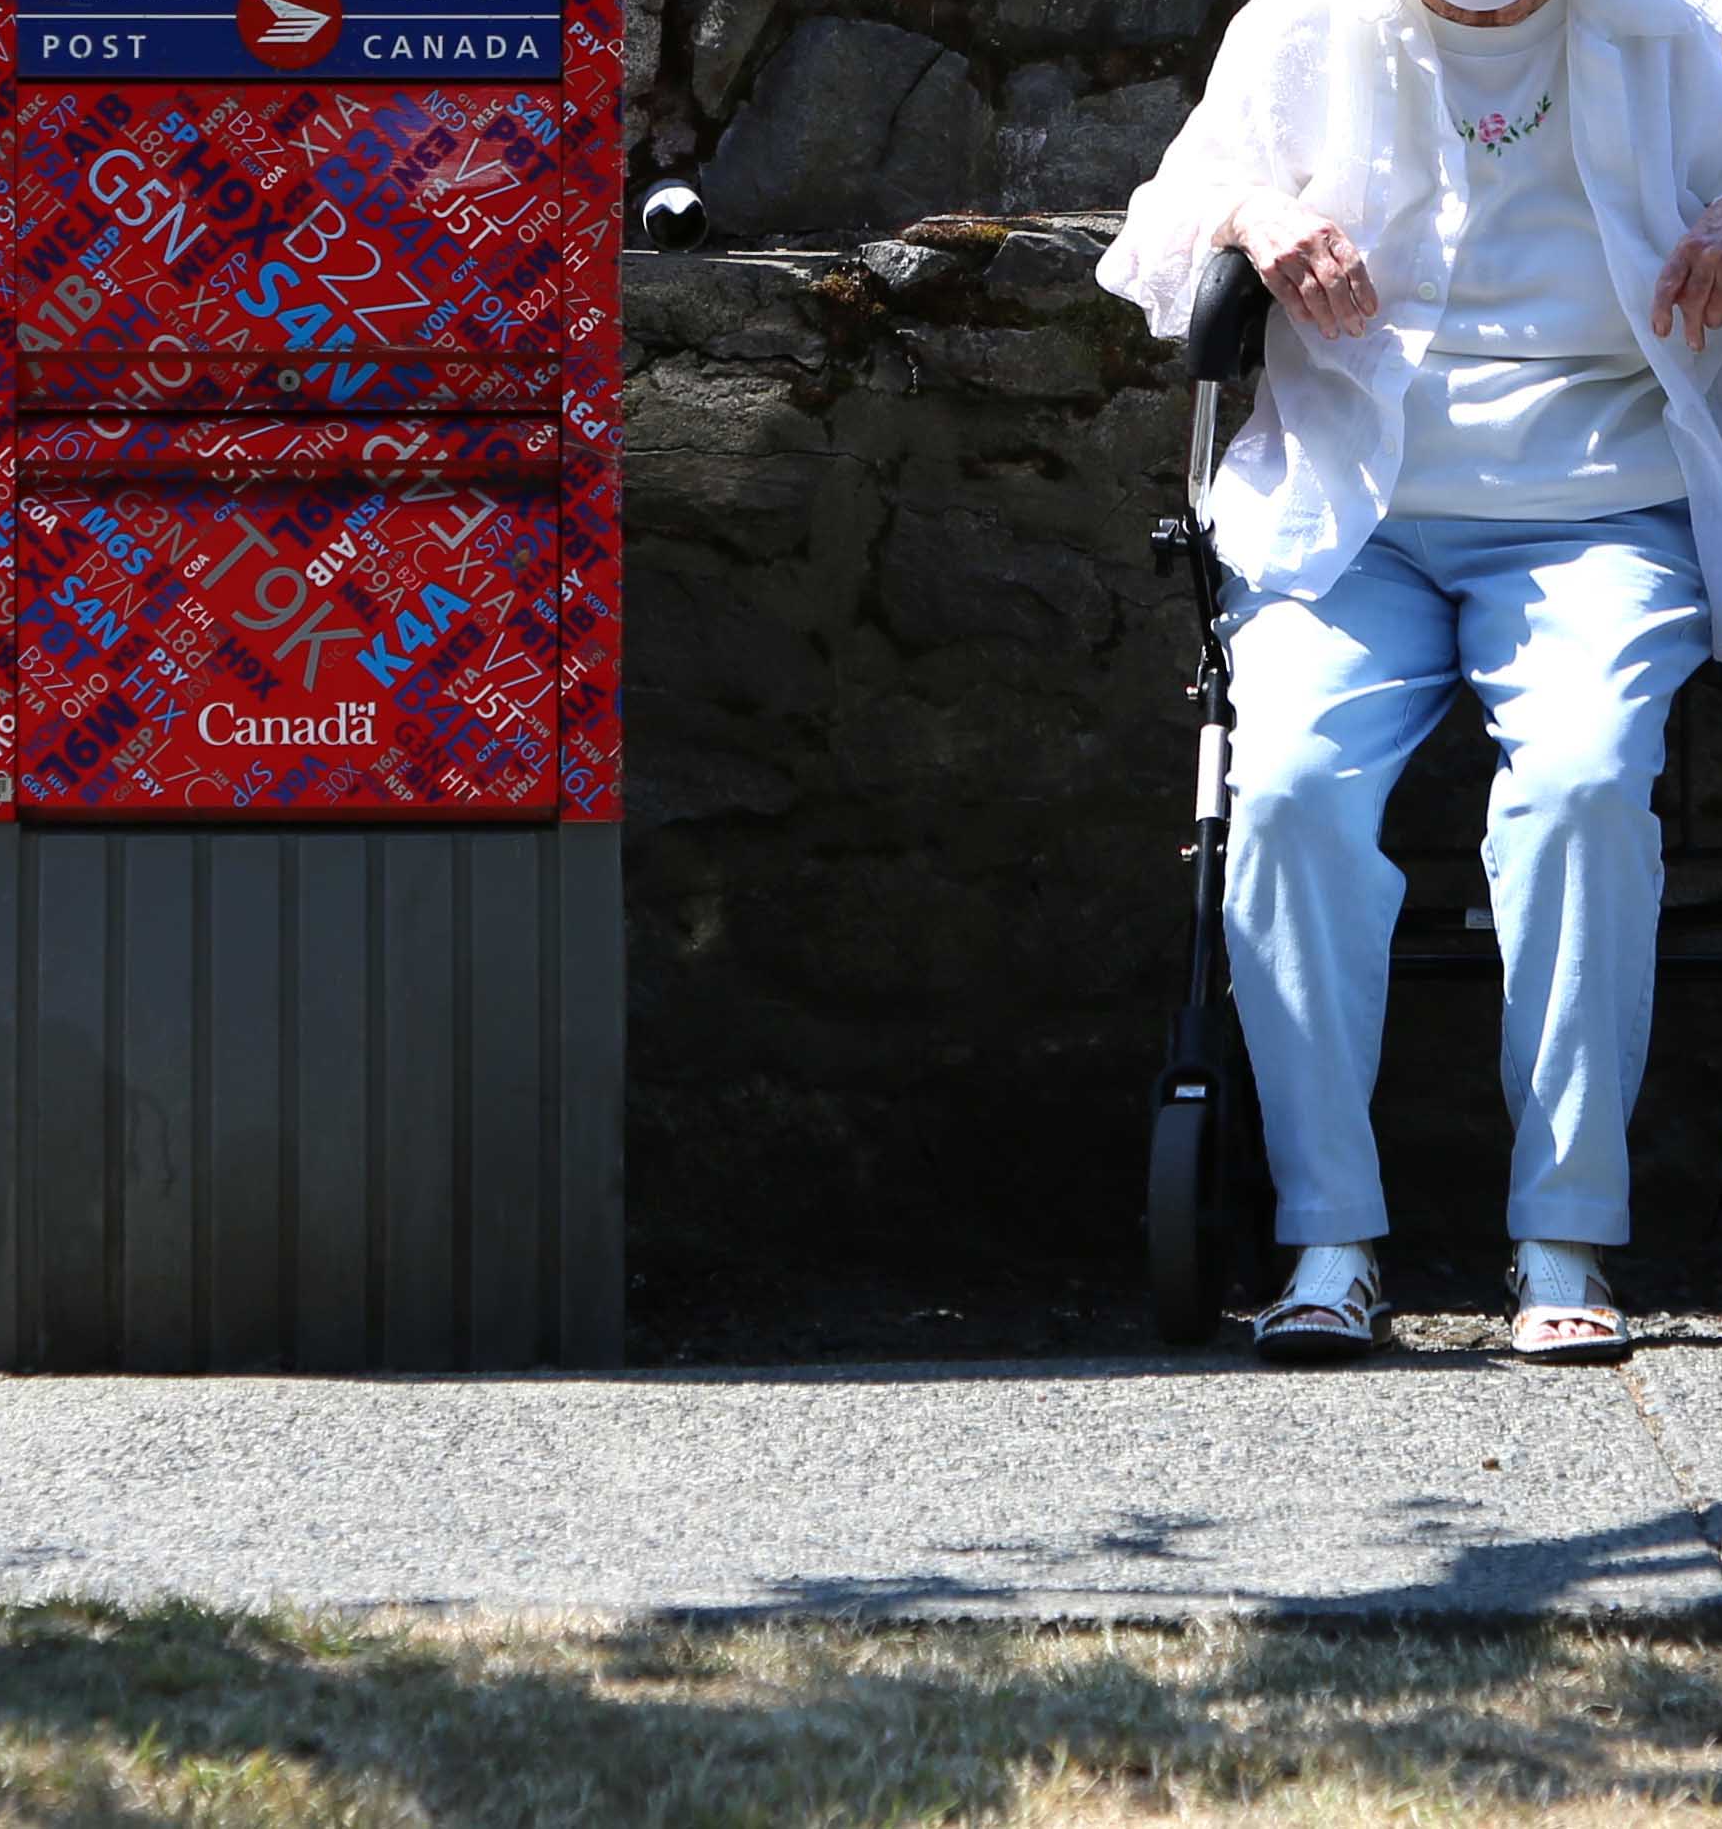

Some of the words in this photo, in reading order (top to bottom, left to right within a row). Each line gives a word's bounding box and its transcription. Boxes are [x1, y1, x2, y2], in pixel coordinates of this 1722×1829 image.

[42, 34, 147, 59] POST
[363, 34, 540, 59] CANADA
[568, 21, 606, 57] P3Y
[16, 92, 48, 126] M3C
[39, 94, 79, 139] S7P
[63, 93, 133, 168] A1B
[287, 93, 370, 167] X1A
[422, 89, 468, 133] G5N
[471, 99, 504, 131] M3C
[505, 93, 562, 147] S4N
[120, 120, 179, 168] P8T
[228, 110, 286, 167] B2Z
[314, 92, 433, 207] B3N
[16, 173, 67, 222] H1T
[88, 148, 208, 265] G5N
[409, 177, 453, 214] Y1A
[454, 137, 539, 228] V7J
[432, 195, 503, 251] J5T
[78, 225, 122, 271] N5P
[282, 199, 431, 346] B2Z
[450, 256, 479, 283] G7K
[92, 269, 124, 297] P3Y
[108, 244, 181, 315] L7C
[210, 252, 248, 296] S7P
[179, 284, 251, 353] X1A
[461, 275, 525, 346] T9K
[516, 278, 560, 322] B2J
[16, 274, 103, 379] A1B
[234, 261, 380, 404] S4N
[174, 421, 217, 454] Y1A
[113, 489, 199, 565] G3N
[343, 493, 387, 535] N5P
[474, 514, 514, 558] S7P
[78, 505, 154, 576] M6S
[305, 531, 358, 588] A1B
[360, 530, 391, 558] P3Y
[376, 506, 448, 575] L7C
[76, 550, 149, 622] R7N
[200, 513, 367, 694] T9K
[349, 554, 406, 615] P9A
[395, 566, 423, 592] B2J
[445, 547, 517, 625] X1A
[49, 576, 129, 650] S4N
[176, 596, 216, 632] H2T
[583, 591, 610, 618] G6X
[18, 598, 101, 670] P8T
[155, 618, 214, 670] P8T
[355, 582, 472, 690] K4A
[16, 645, 74, 702] B2Z
[147, 646, 191, 686] P3Y
[441, 667, 483, 702] Y1A
[483, 631, 555, 710] V7J
[16, 681, 47, 716] Y1A
[119, 665, 188, 736] H1X
[393, 668, 492, 767] B4E
[462, 682, 526, 733] J5T
[197, 701, 379, 746] Canada
[111, 727, 156, 772] N5P
[145, 737, 223, 808] L7C
[475, 737, 502, 763] G7K
[505, 724, 551, 776] T9K
[569, 731, 605, 766] M3C
[21, 773, 51, 802] G6X
[132, 768, 166, 800] P3Y
[232, 759, 275, 808] S7P
[384, 774, 415, 803] N5P
[440, 767, 482, 805] H1T
[485, 767, 518, 797] T1C
